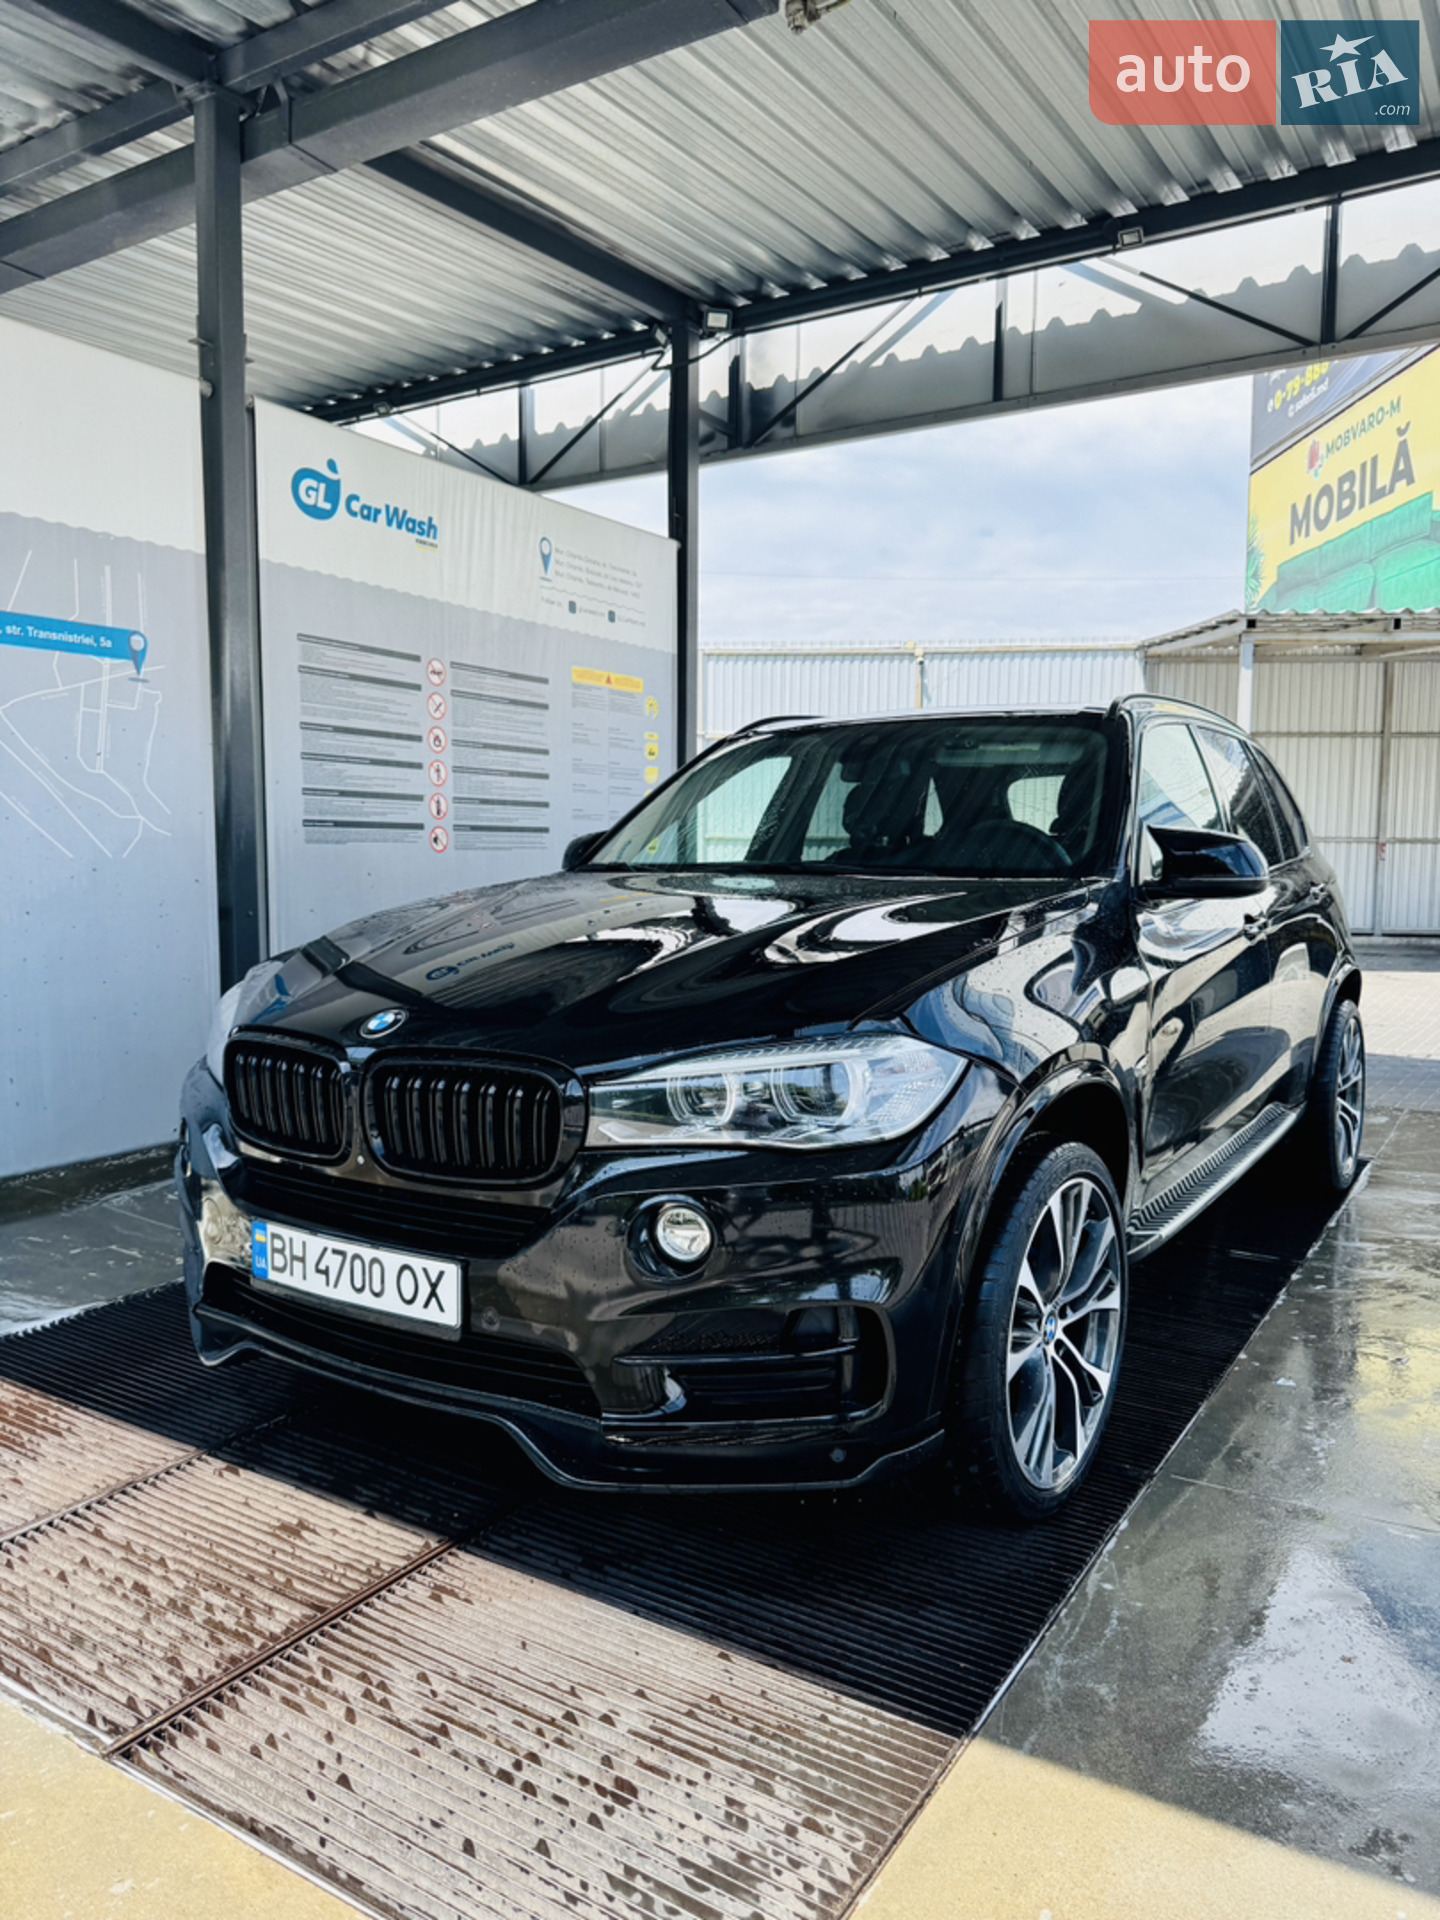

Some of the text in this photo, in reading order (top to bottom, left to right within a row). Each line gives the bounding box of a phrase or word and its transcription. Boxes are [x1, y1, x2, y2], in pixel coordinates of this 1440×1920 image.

[1325, 395, 1402, 460] MOBVARO-M
[298, 478, 332, 511] GL
[1289, 421, 1416, 546] MOBILĂ
[345, 493, 438, 540] Car Wash
[5, 625, 24, 637] str.
[270, 1232, 446, 1313] BH 4700 OX
